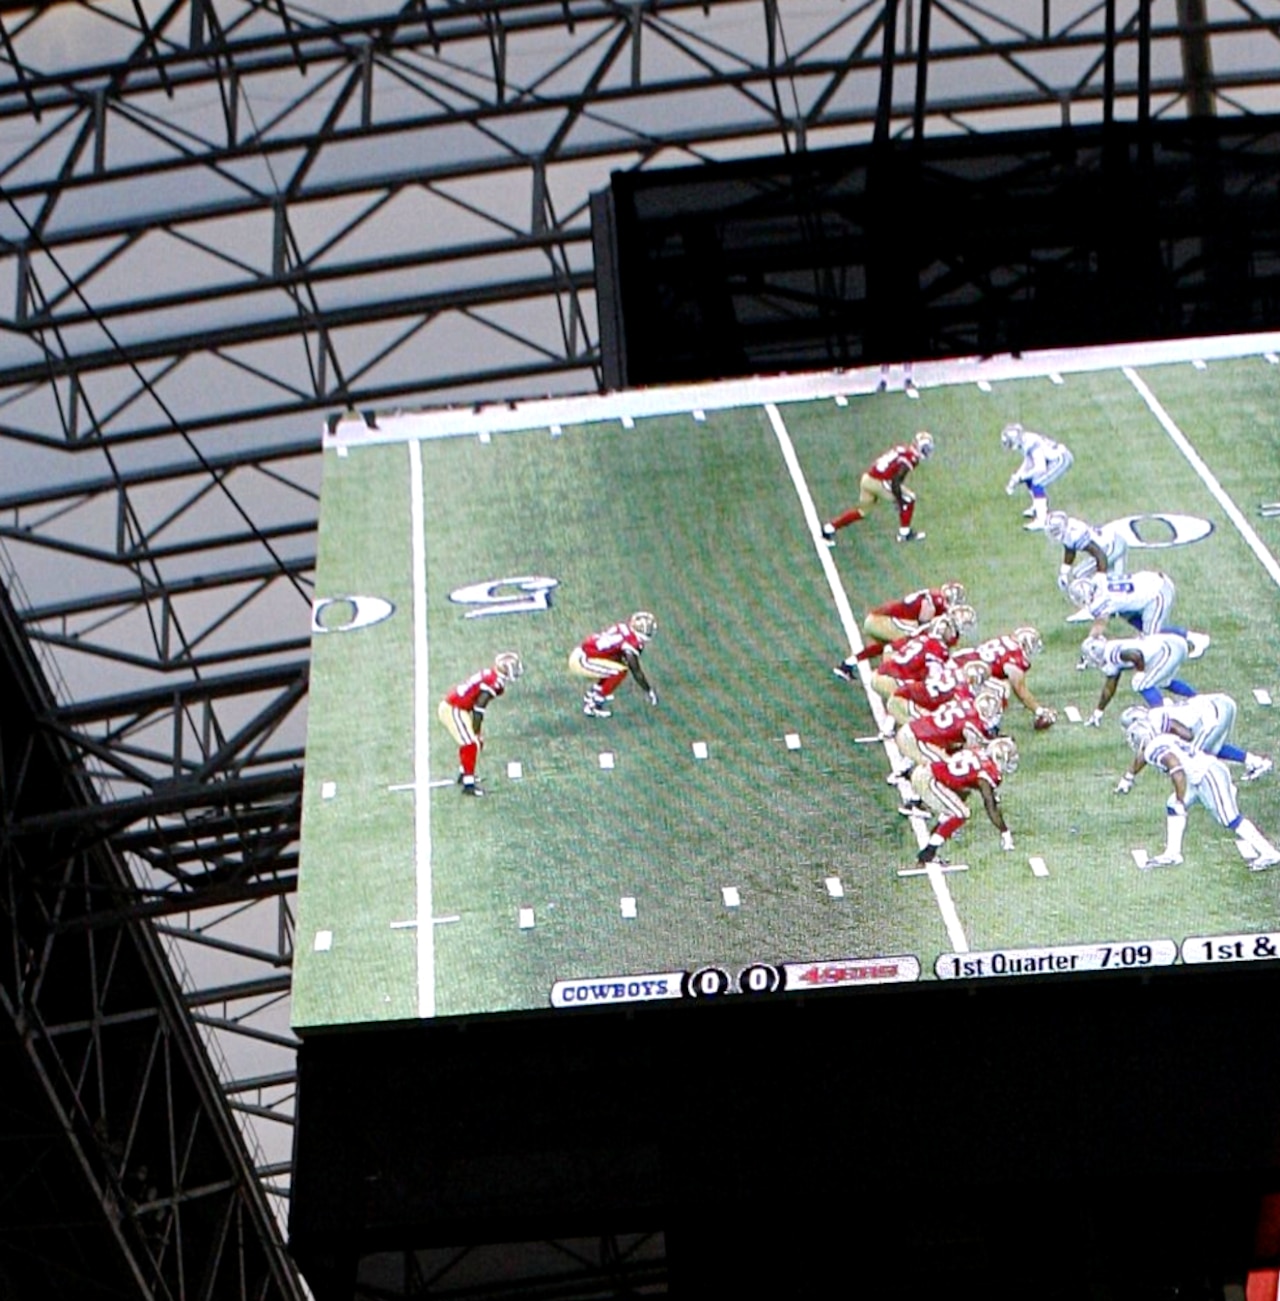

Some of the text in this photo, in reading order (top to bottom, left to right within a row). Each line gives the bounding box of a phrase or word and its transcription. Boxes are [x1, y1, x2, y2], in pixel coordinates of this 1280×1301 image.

[951, 945, 1153, 977] 1st Quarter 7:09
[1203, 938, 1245, 961] 1st
[1252, 936, 1277, 958] &
[561, 980, 669, 1002] COWBOYS
[701, 972, 719, 994] 0
[750, 968, 768, 991] 0
